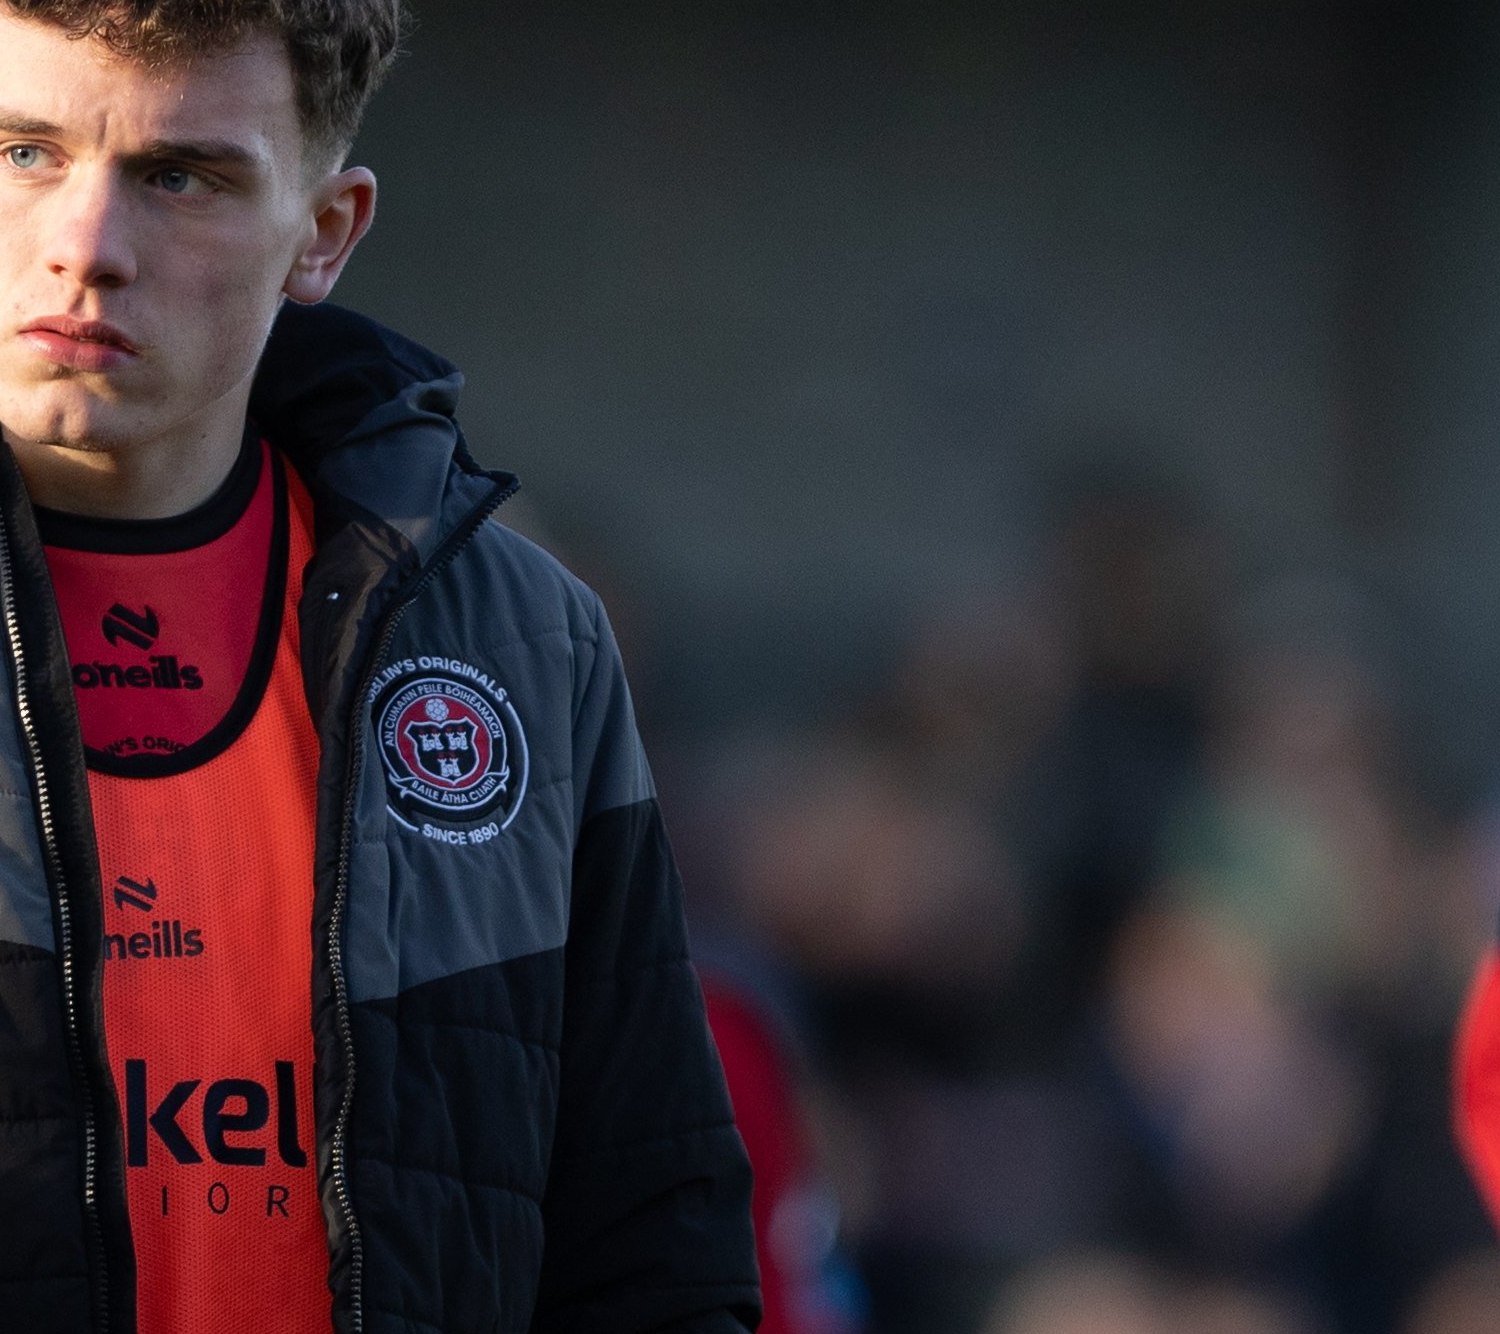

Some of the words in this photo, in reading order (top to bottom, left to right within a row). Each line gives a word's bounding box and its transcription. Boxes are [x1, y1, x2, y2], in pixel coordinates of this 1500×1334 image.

[419, 656, 507, 703] ORIGINALS
[386, 689, 418, 729] CUMANN
[417, 683, 443, 696] PEILE
[411, 780, 439, 801] BAILE
[470, 777, 497, 801] CLIATH
[422, 823, 467, 845] SINCE
[468, 822, 500, 845] 1890
